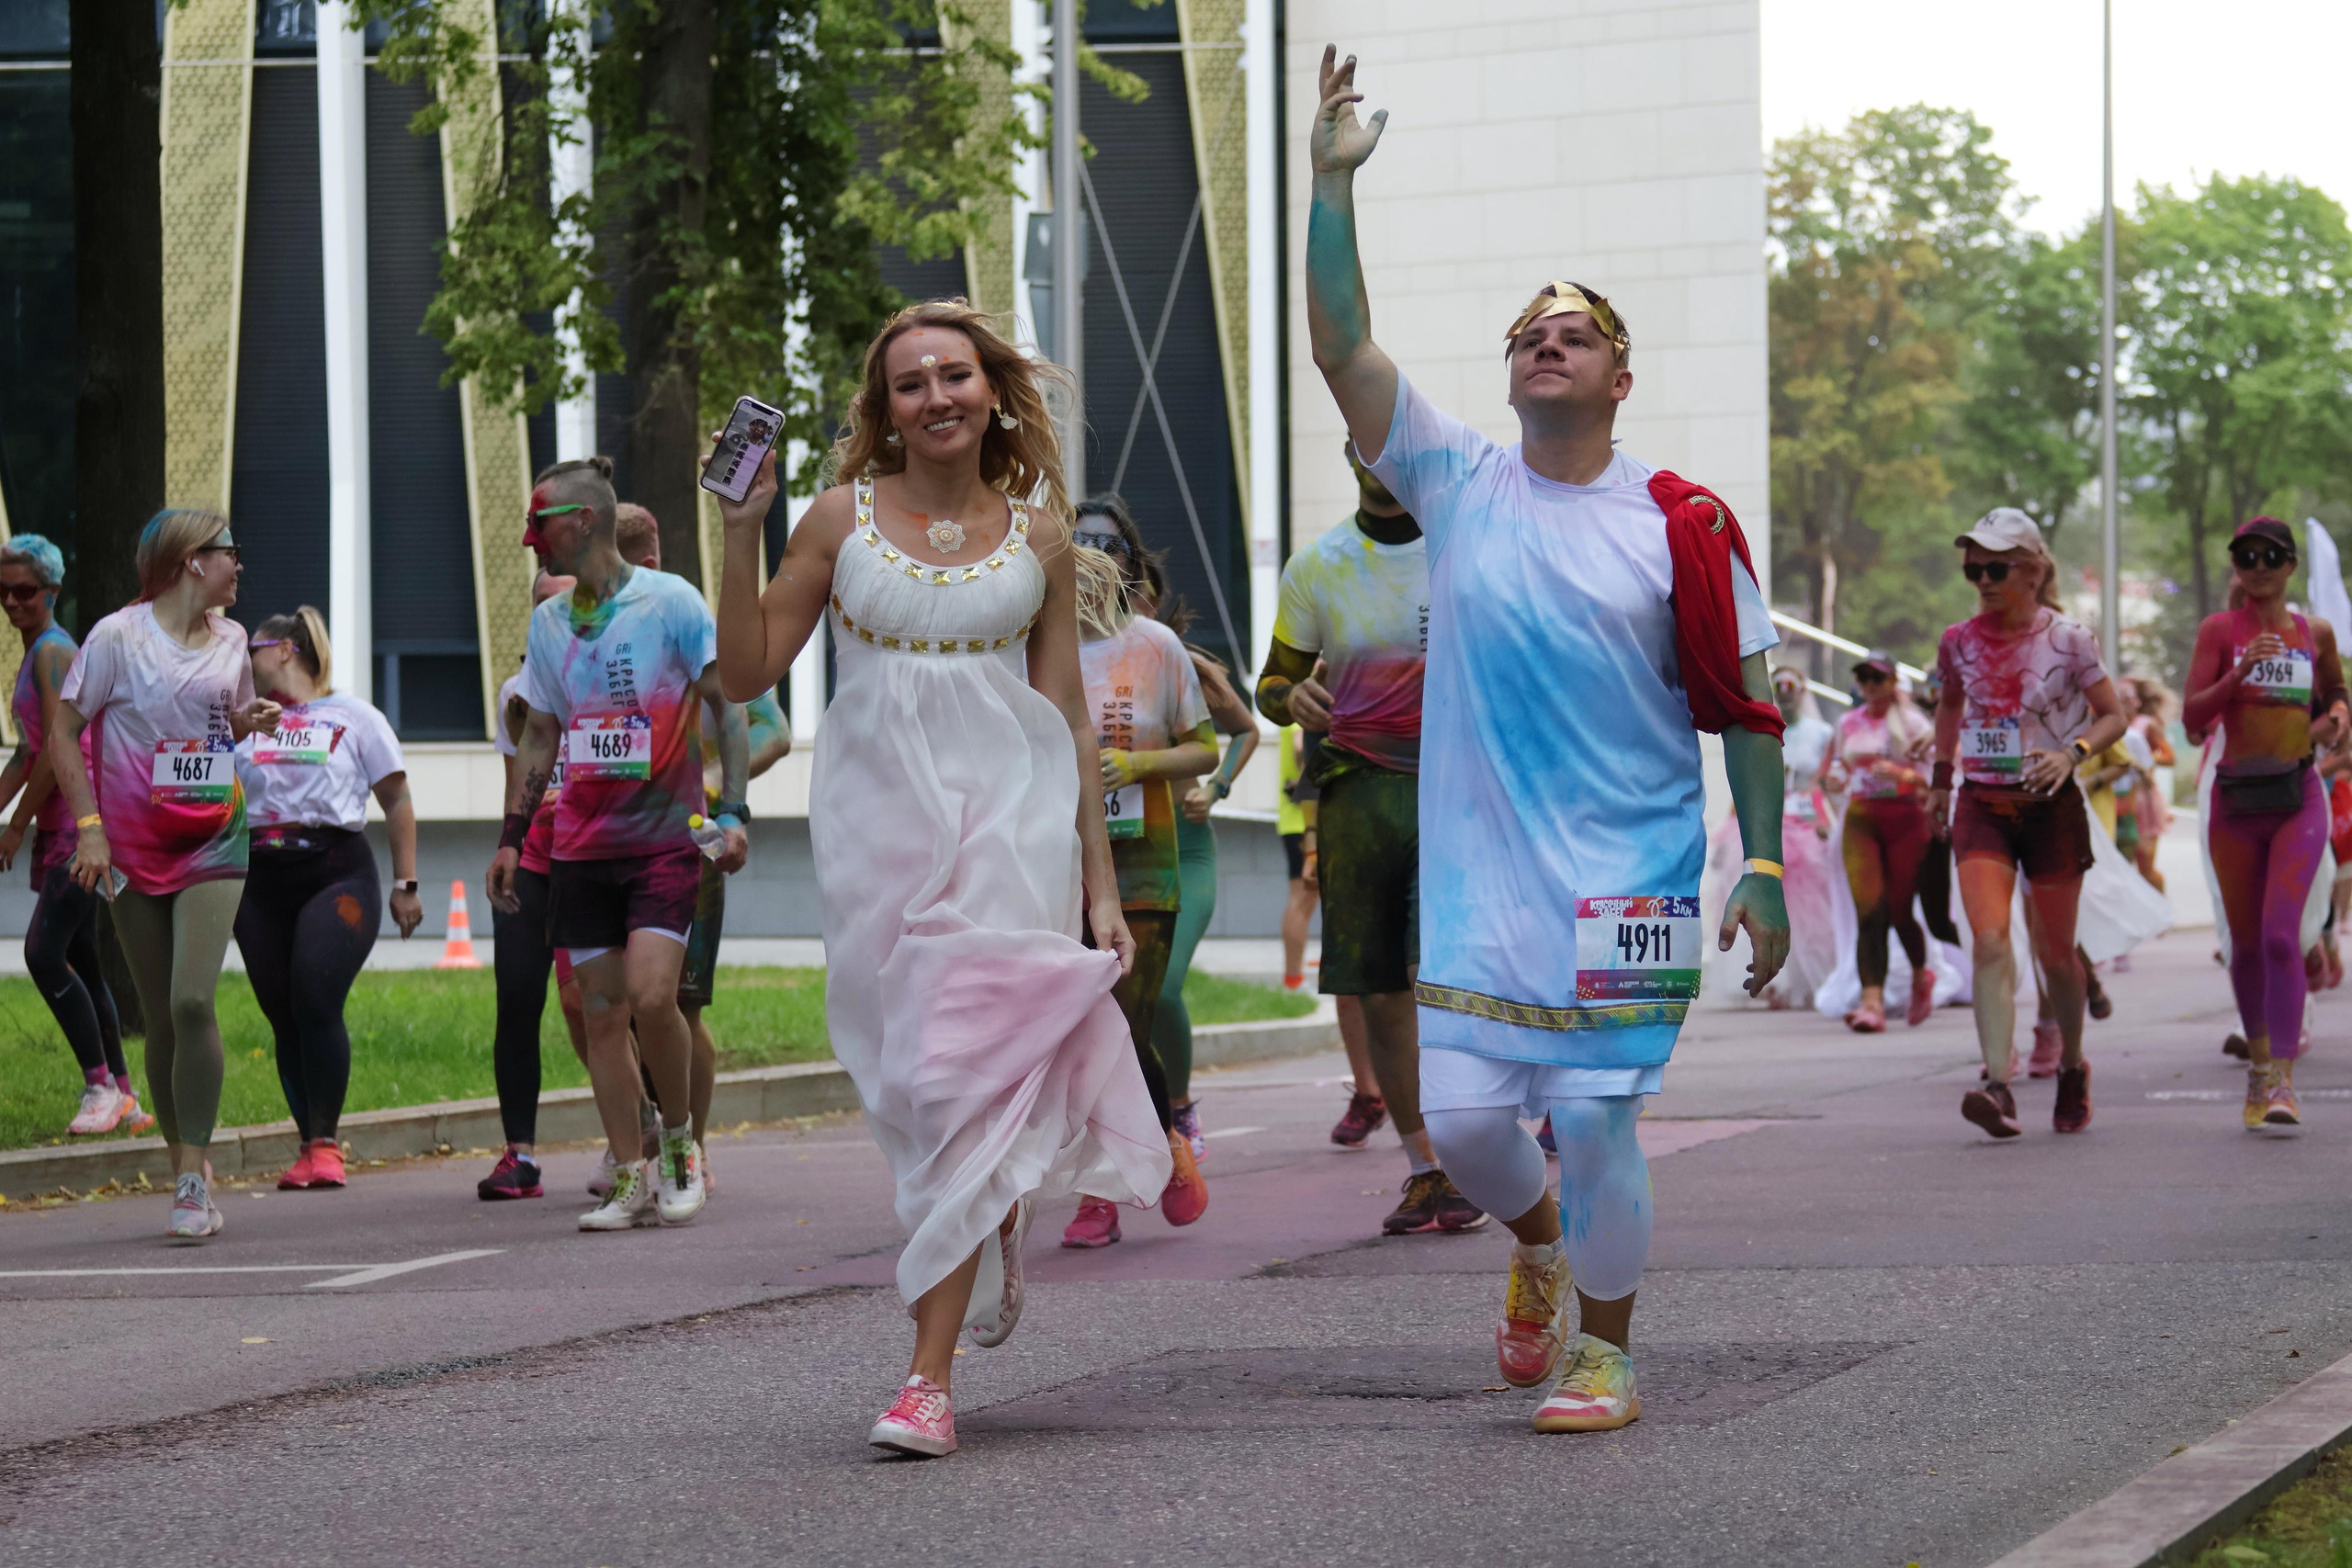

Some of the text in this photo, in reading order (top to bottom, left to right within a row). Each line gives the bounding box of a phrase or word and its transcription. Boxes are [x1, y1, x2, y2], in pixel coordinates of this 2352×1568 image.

[606, 660, 625, 706] ЗАБЕГ
[2255, 661, 2292, 682] 3964
[1102, 702, 1117, 750] ЗАБЕ
[276, 730, 312, 747] 4105
[591, 734, 631, 758] 4689
[1976, 732, 2007, 753] 3965
[173, 756, 214, 781] 4687
[1617, 923, 1670, 964] 4911
